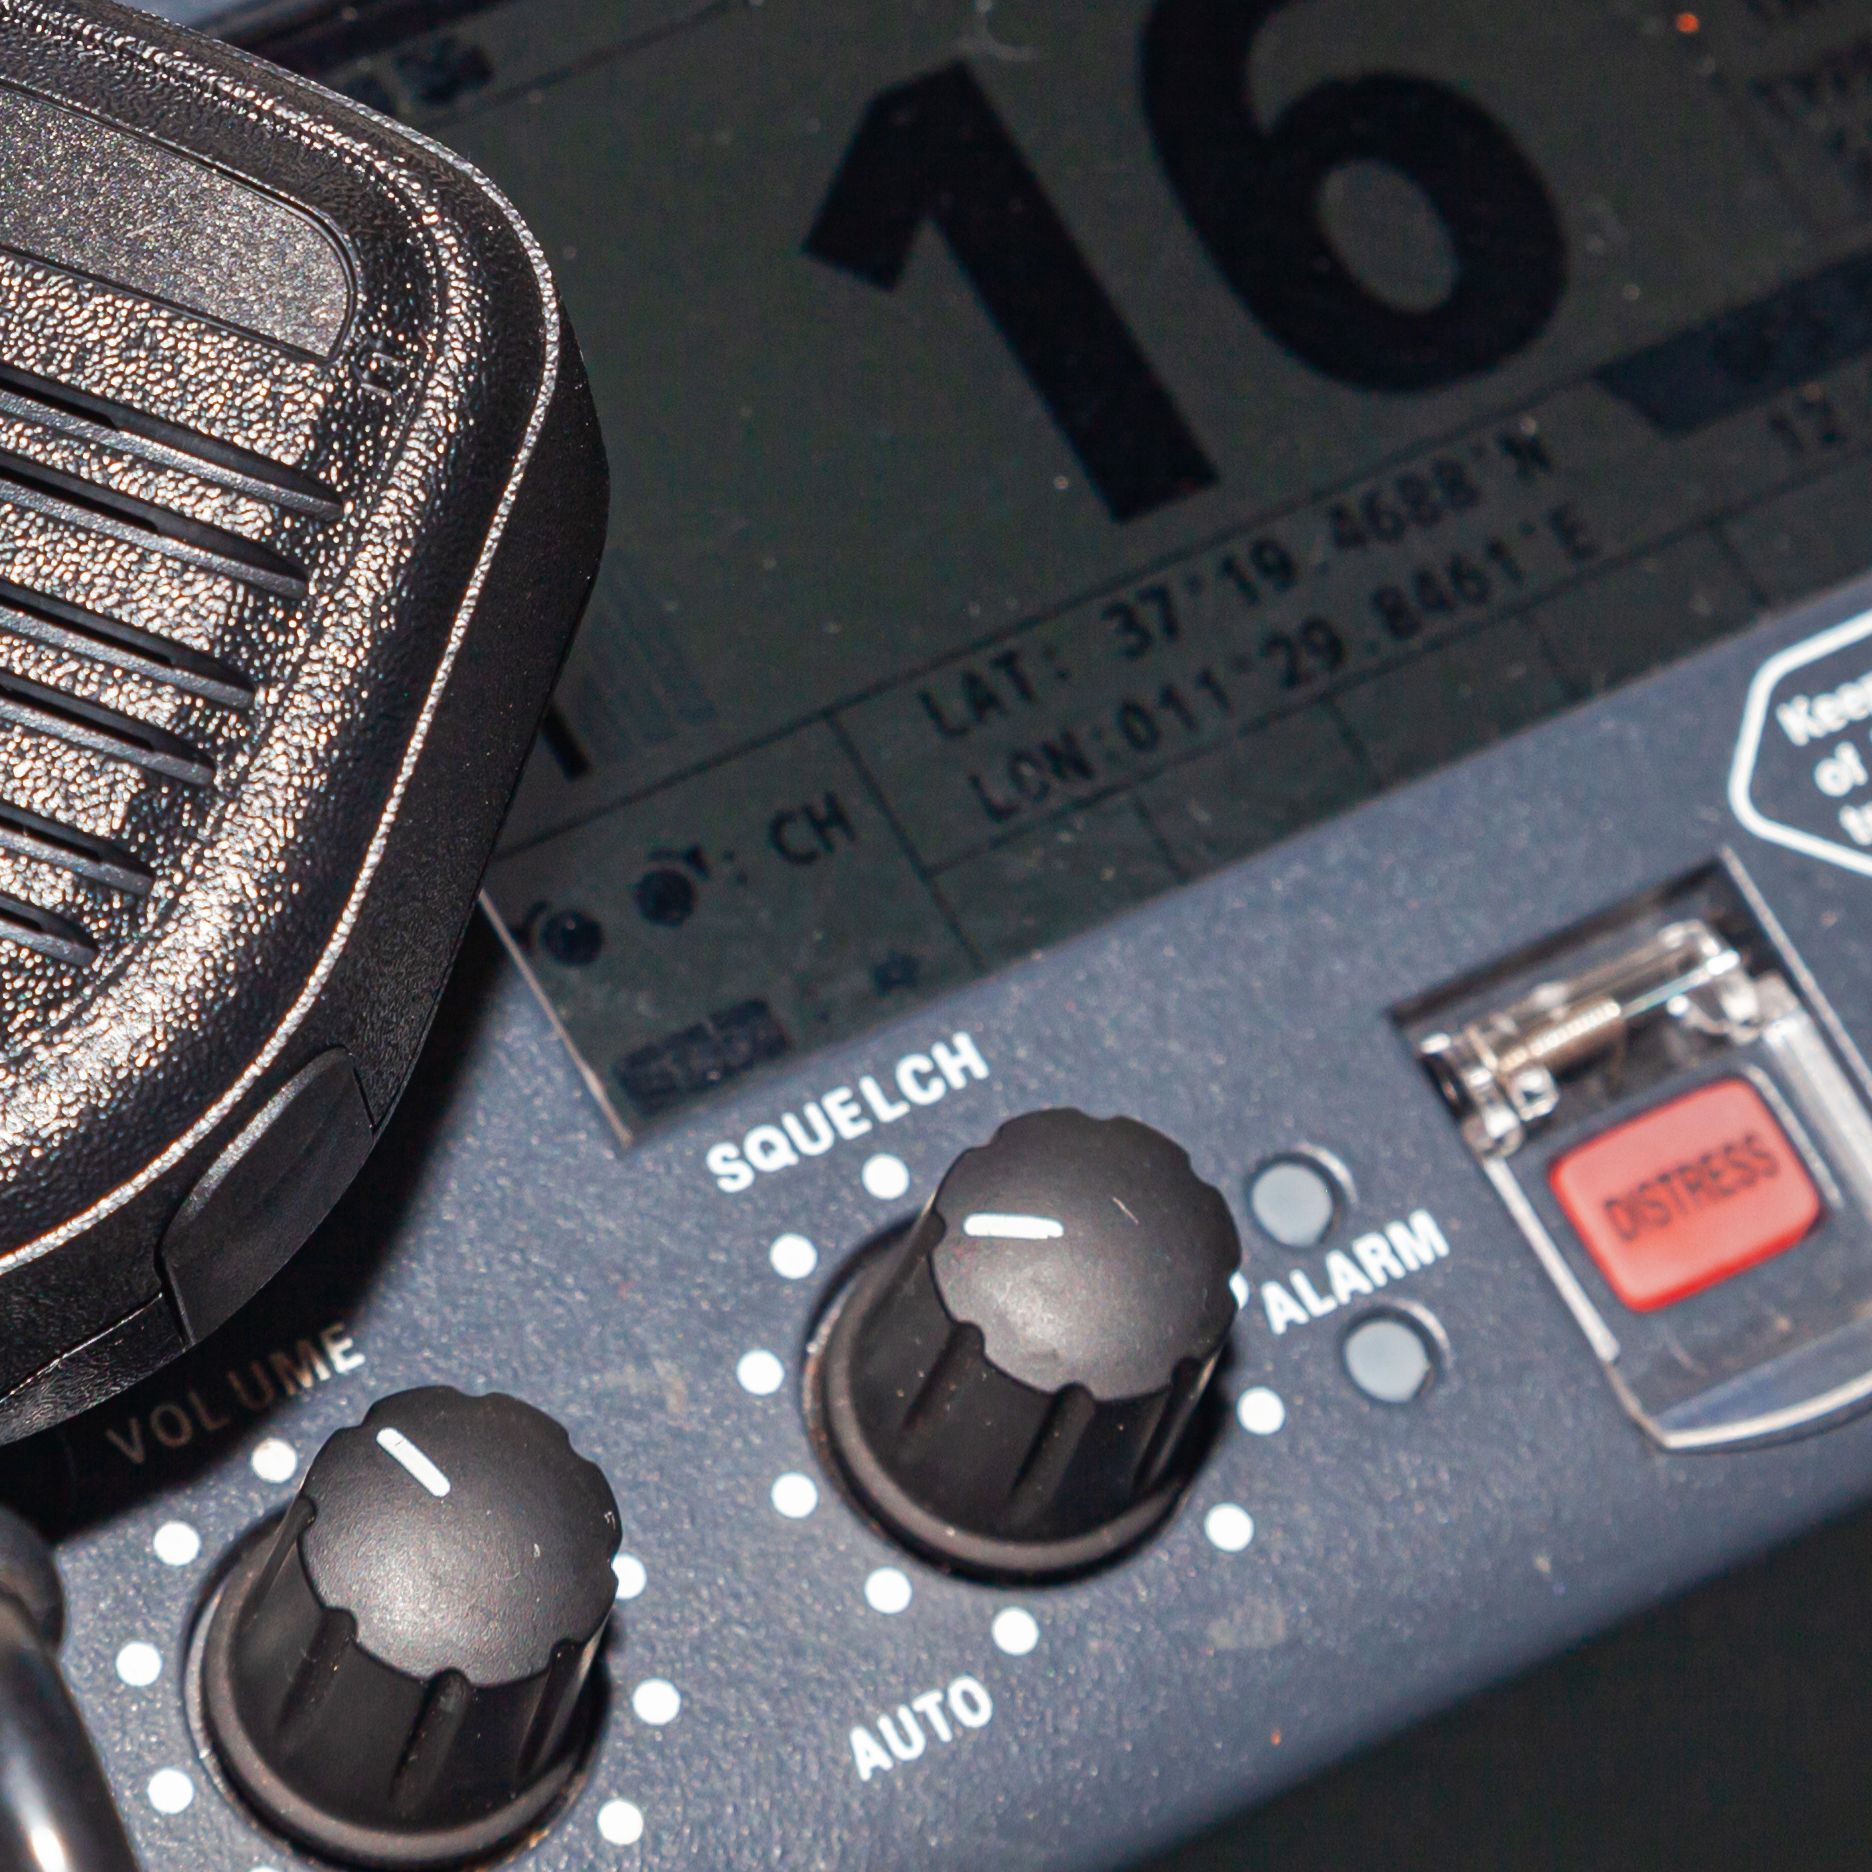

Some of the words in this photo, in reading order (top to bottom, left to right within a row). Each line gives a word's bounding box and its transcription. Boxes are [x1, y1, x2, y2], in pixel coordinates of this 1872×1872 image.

[1815, 742, 1868, 797] of
[705, 1031, 992, 1197] SQUELCH
[1602, 1133, 1780, 1244] DISTRESS
[1260, 1209, 1453, 1336] ALARM
[105, 1321, 366, 1466] VOLUME
[848, 1675, 997, 1784] AUTO
